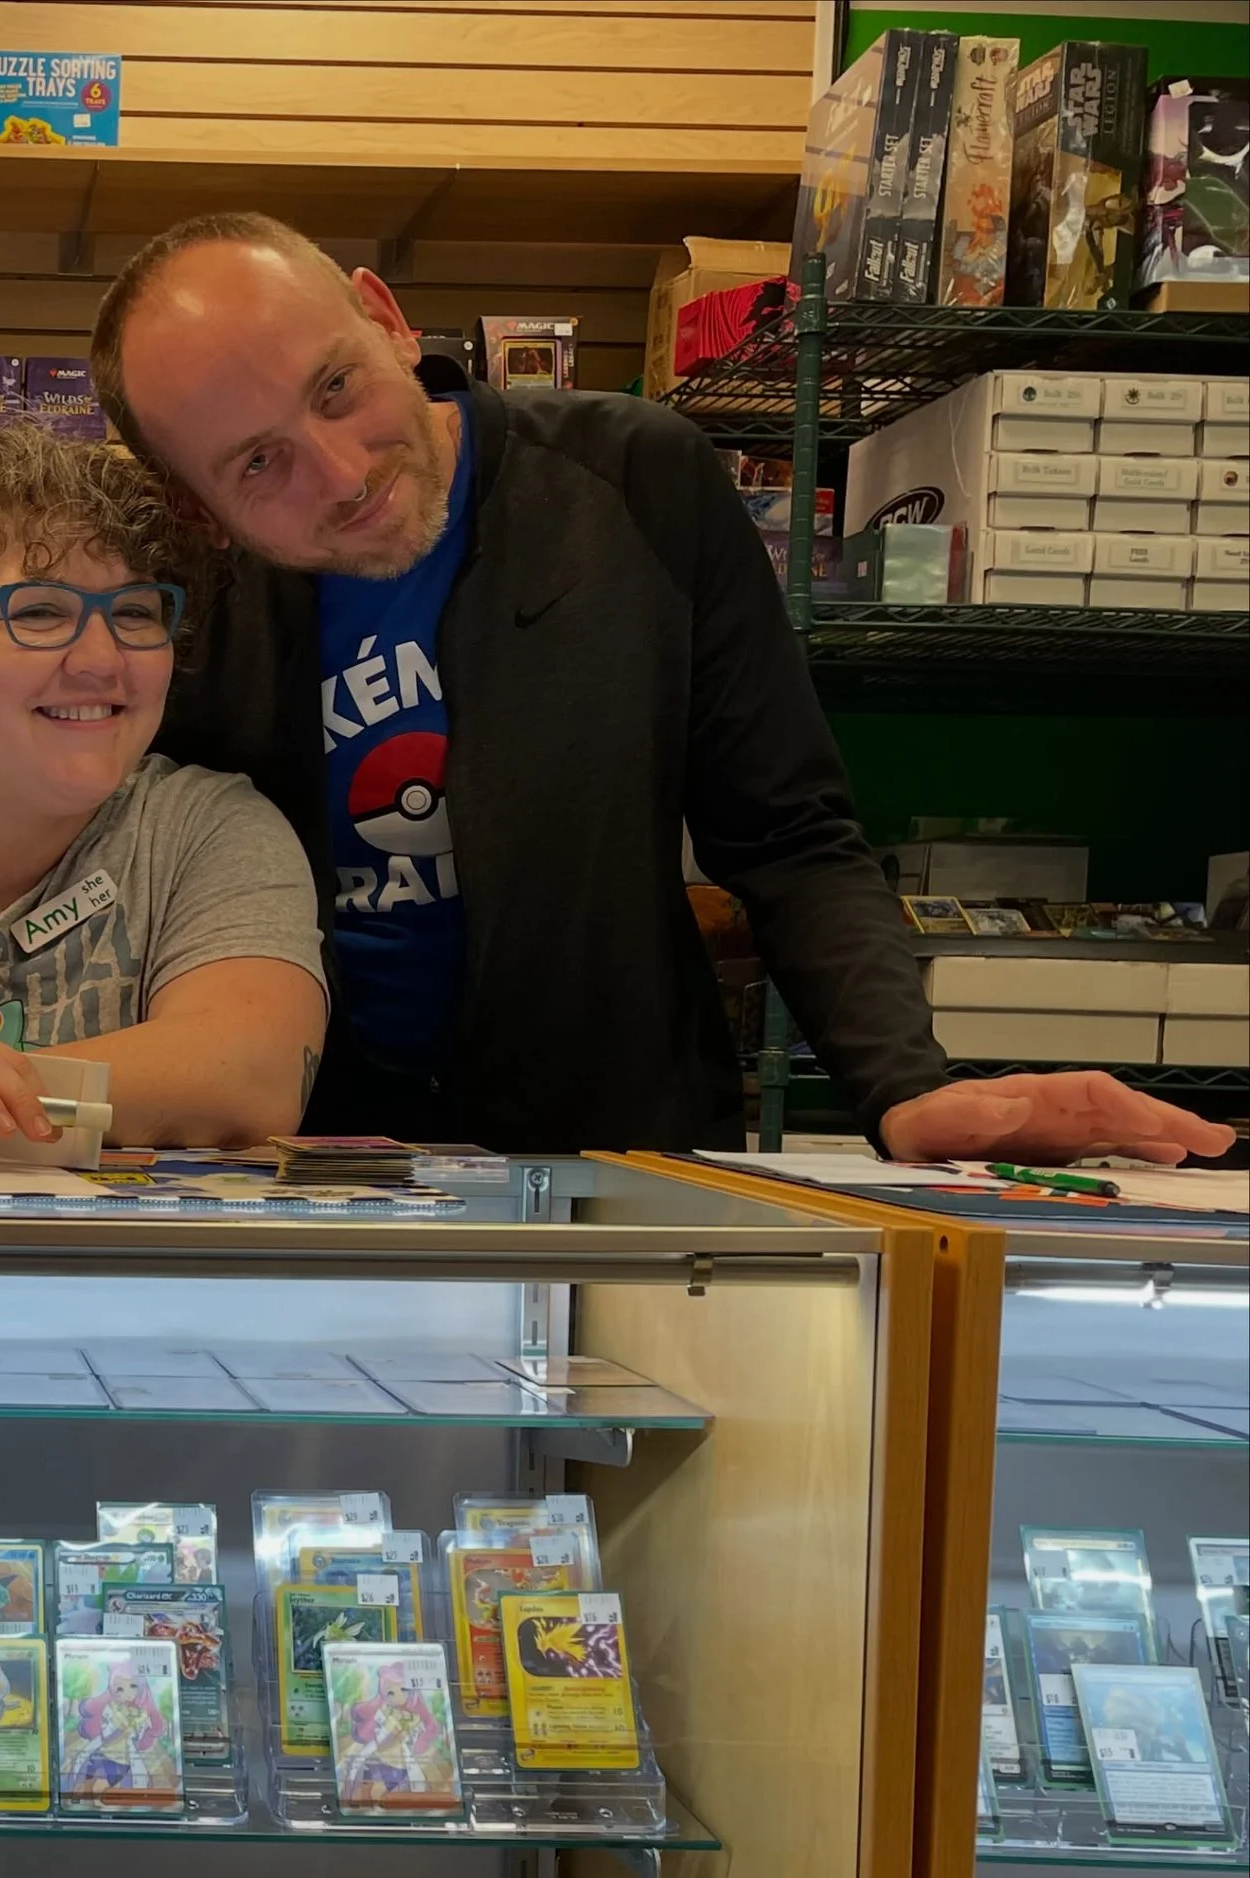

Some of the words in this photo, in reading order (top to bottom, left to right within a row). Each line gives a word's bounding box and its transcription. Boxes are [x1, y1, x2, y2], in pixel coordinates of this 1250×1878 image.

[50, 58, 117, 79] SORTING
[27, 76, 76, 97] TRAYS
[90, 83, 101, 98] 6
[1069, 62, 1093, 128] STAR
[1081, 63, 1102, 136] WARS
[1103, 71, 1118, 135] LEGION
[962, 77, 997, 165] Flamecraft
[886, 134, 900, 151] SET
[919, 136, 934, 153] SET
[878, 155, 896, 197] STARTER
[913, 156, 932, 199] STARTER
[864, 239, 884, 281] Fallout
[899, 241, 920, 283] Fallout
[516, 321, 555, 331] MAGIC
[57, 370, 86, 378] MAGIC
[43, 391, 84, 404] WILDS
[39, 404, 95, 415] ELDRAINE
[81, 873, 105, 896] she
[88, 887, 113, 908] her
[25, 897, 83, 944] Amy
[127, 1591, 160, 1600] Charizard
